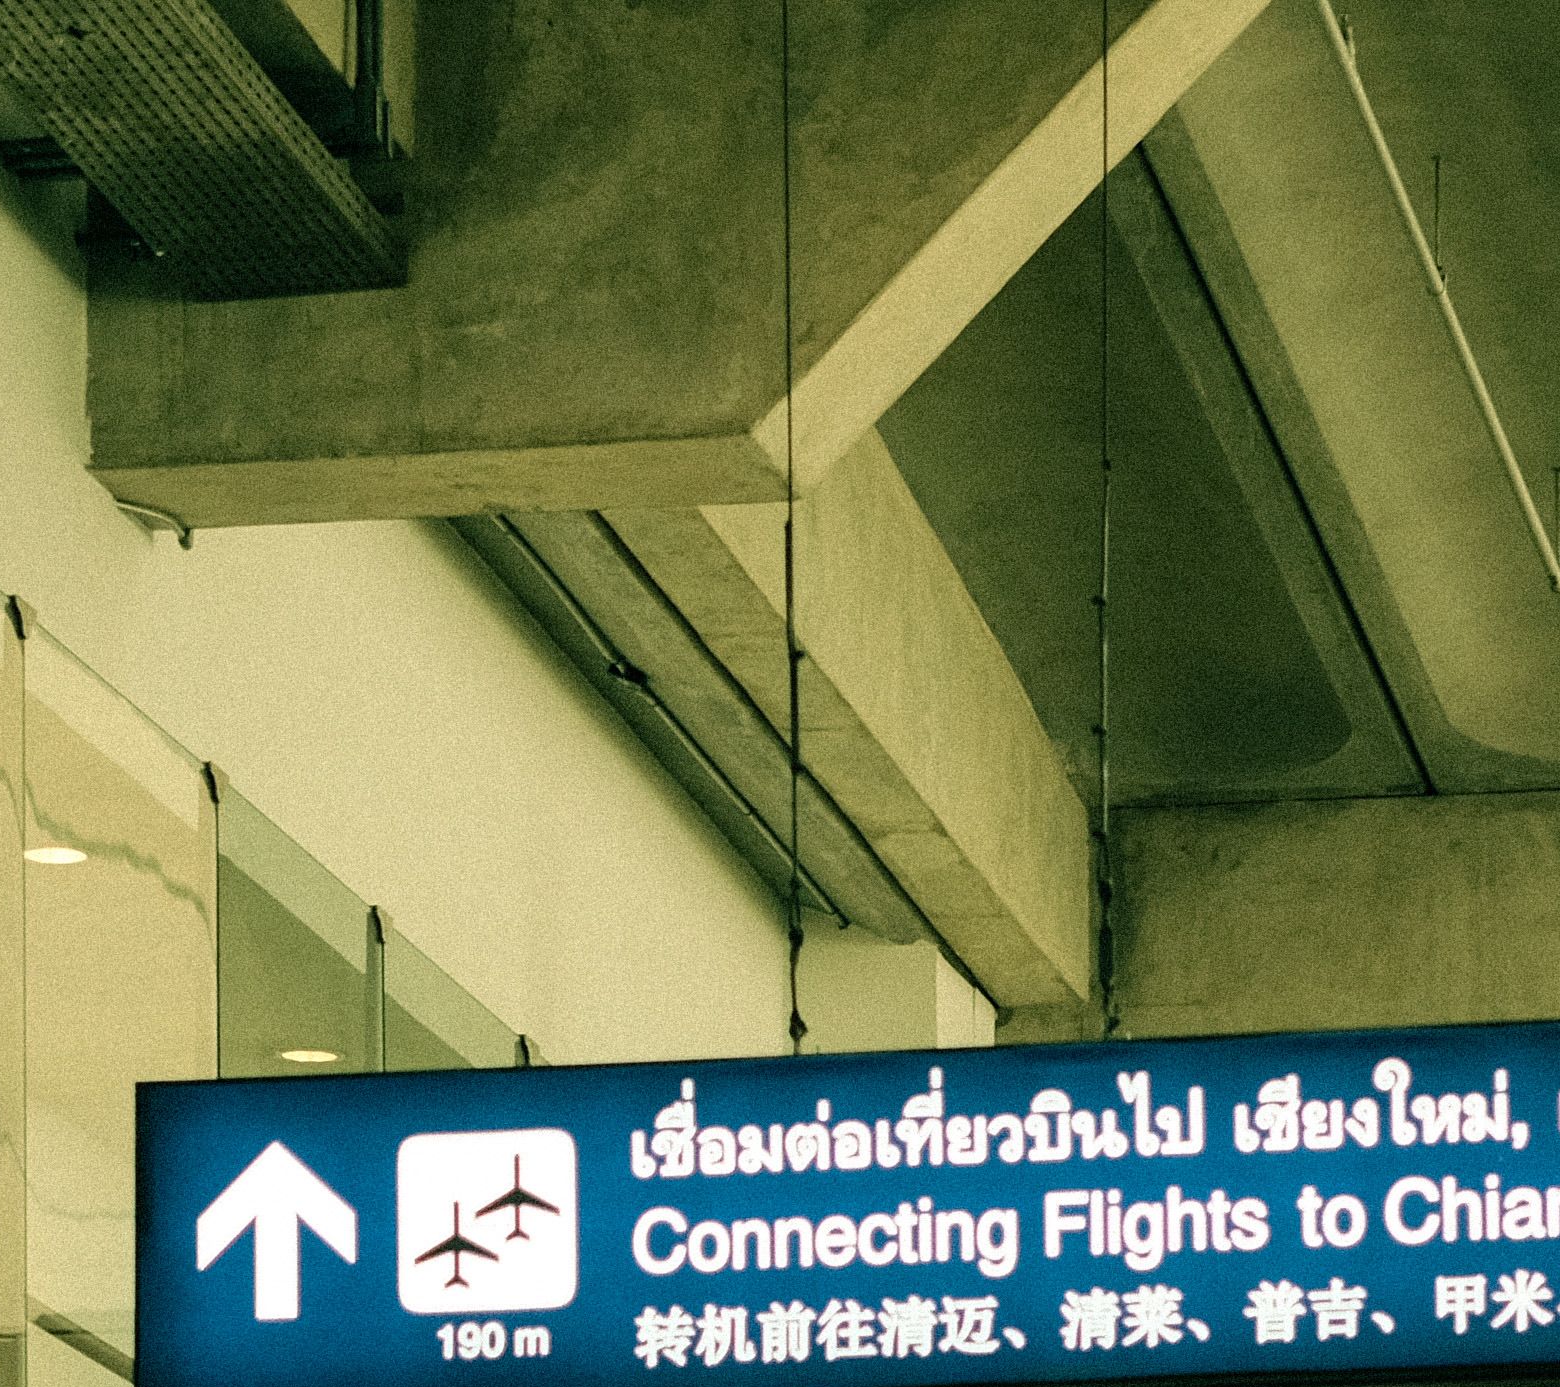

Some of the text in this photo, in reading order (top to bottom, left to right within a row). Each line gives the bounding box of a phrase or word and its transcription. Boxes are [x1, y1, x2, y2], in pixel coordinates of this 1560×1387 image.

[630, 1067, 1207, 1180] เชื่อมต่อเที่ยวบินไป
[1233, 1057, 1530, 1154] เชียงใหม่,
[631, 1196, 1020, 1278] Connecting
[1043, 1185, 1270, 1272] Flights
[1296, 1185, 1368, 1249] to
[436, 1320, 551, 1360] 190 m
